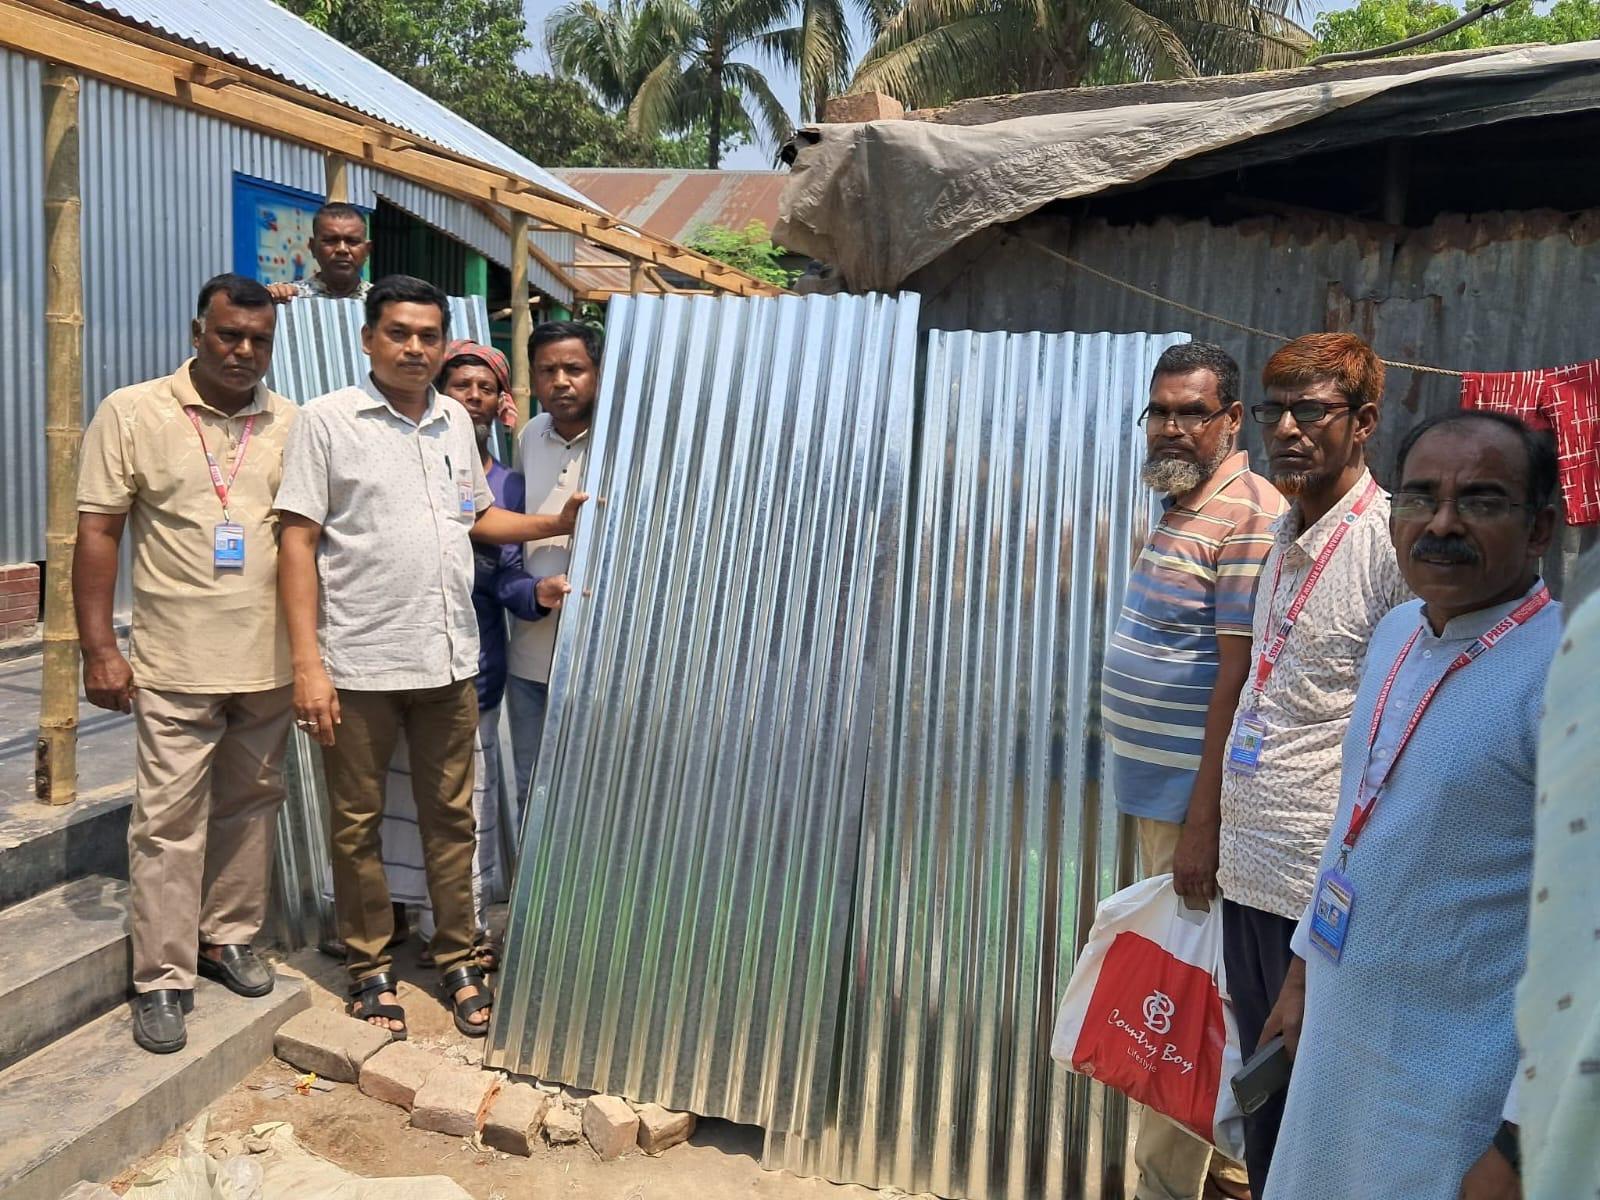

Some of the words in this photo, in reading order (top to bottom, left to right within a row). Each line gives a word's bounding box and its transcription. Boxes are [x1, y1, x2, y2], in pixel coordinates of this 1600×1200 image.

[1328, 524, 1346, 549] HUMAN
[1315, 548, 1332, 571] RIGHTS
[1302, 570, 1318, 593] REVIEW
[1288, 593, 1306, 618] SOCIETY
[1486, 617, 1513, 640] PRESS
[1269, 638, 1282, 658] PRESS
[1411, 692, 1431, 722] REVIEW
[1107, 1008, 1157, 1058] Country
[1161, 1043, 1193, 1074] Boy
[1127, 1045, 1158, 1073] Lifestyle
